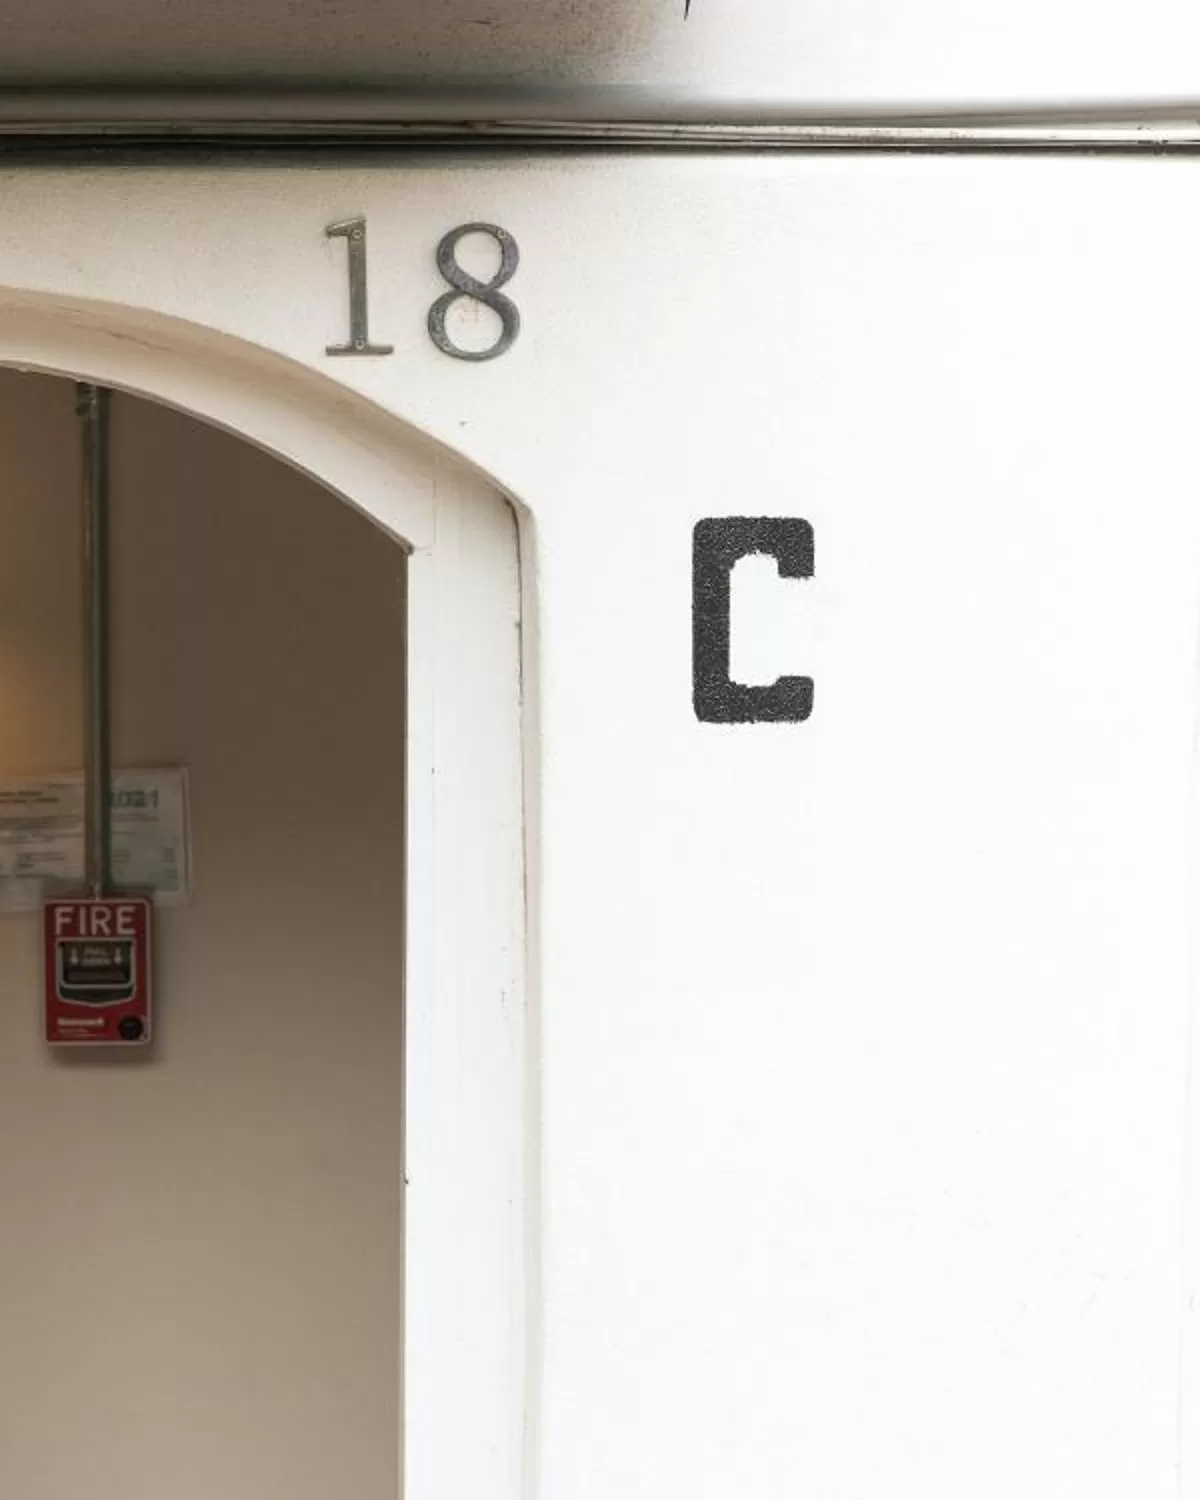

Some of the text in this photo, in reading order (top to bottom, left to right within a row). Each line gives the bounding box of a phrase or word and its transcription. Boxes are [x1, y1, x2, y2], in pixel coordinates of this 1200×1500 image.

[325, 215, 520, 362] 18
[692, 516, 815, 724] C
[54, 905, 137, 935] FIRE
